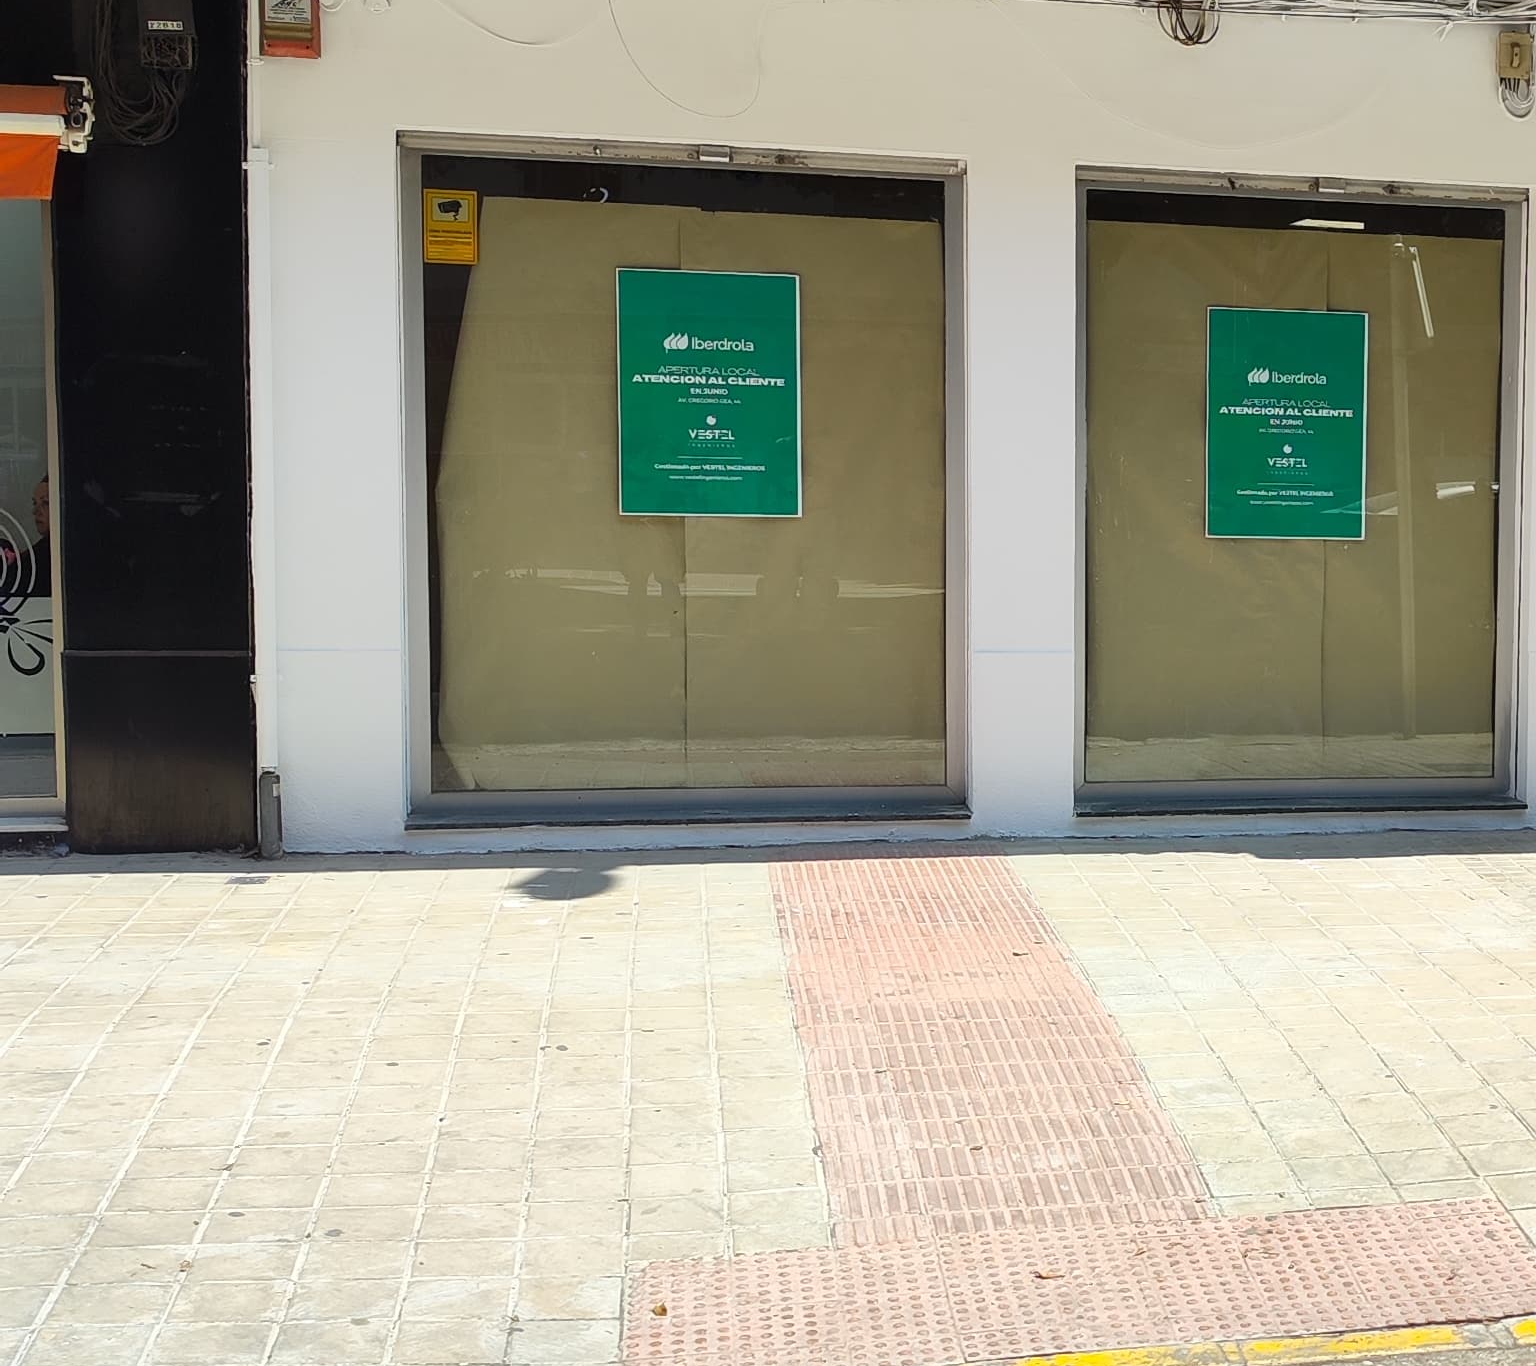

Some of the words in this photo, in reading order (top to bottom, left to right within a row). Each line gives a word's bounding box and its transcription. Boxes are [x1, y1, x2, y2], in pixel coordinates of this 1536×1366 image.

[691, 336, 754, 352] Iberdrola
[657, 365, 719, 375] APERTURA
[721, 367, 760, 377] LOCAL
[632, 374, 706, 385] ATENCION
[708, 376, 726, 385] AL
[728, 377, 785, 387] CLIENTE
[1271, 371, 1327, 385] Iberdrola
[1241, 398, 1296, 407] APERTURA
[1298, 399, 1331, 408] LOCAL
[1219, 406, 1285, 416] ATENCION
[1286, 407, 1301, 416] AL
[1303, 408, 1354, 418] CLIENTE
[688, 428, 735, 440] VESTEL
[1266, 457, 1308, 468] VESTEL
